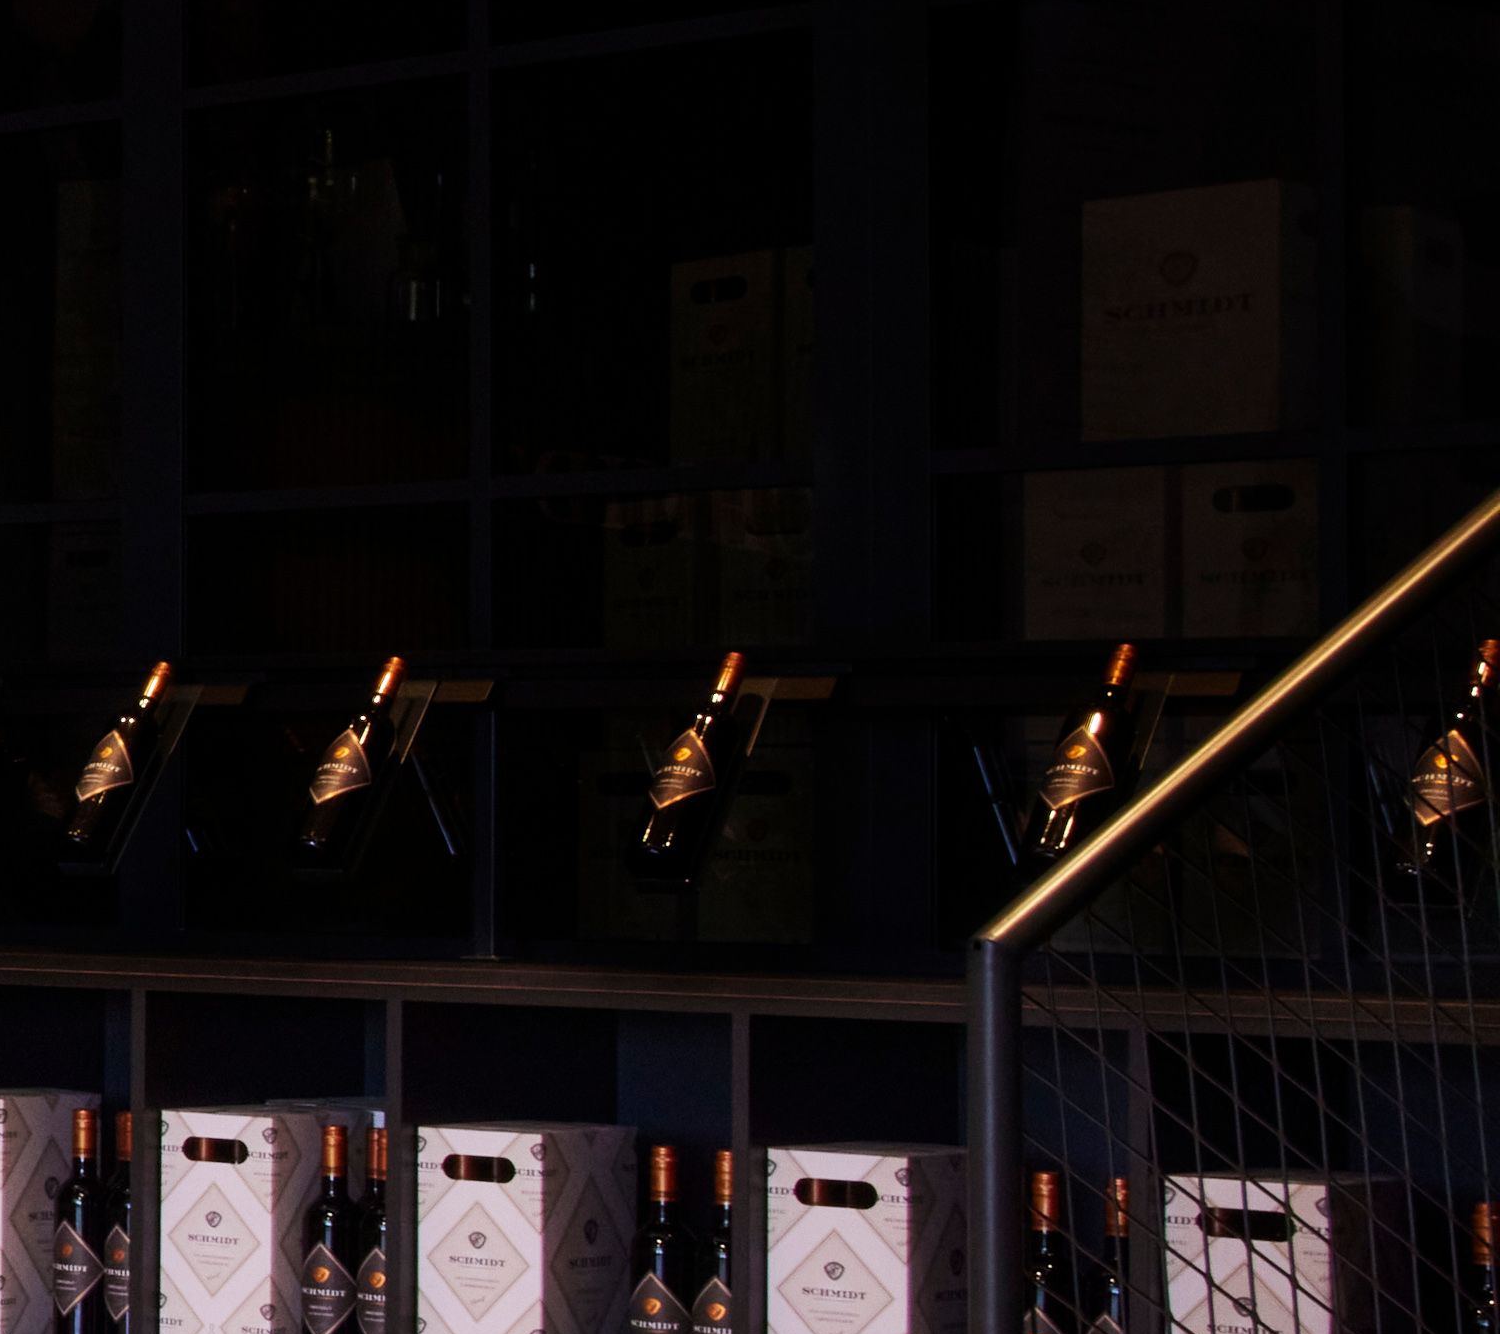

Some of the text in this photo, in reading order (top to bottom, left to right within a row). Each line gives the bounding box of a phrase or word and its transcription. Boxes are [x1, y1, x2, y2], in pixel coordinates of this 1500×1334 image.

[187, 1233, 240, 1246] SCHMIDT
[448, 1255, 507, 1268] SCHMIDT
[801, 1286, 868, 1301] SCHMIDT
